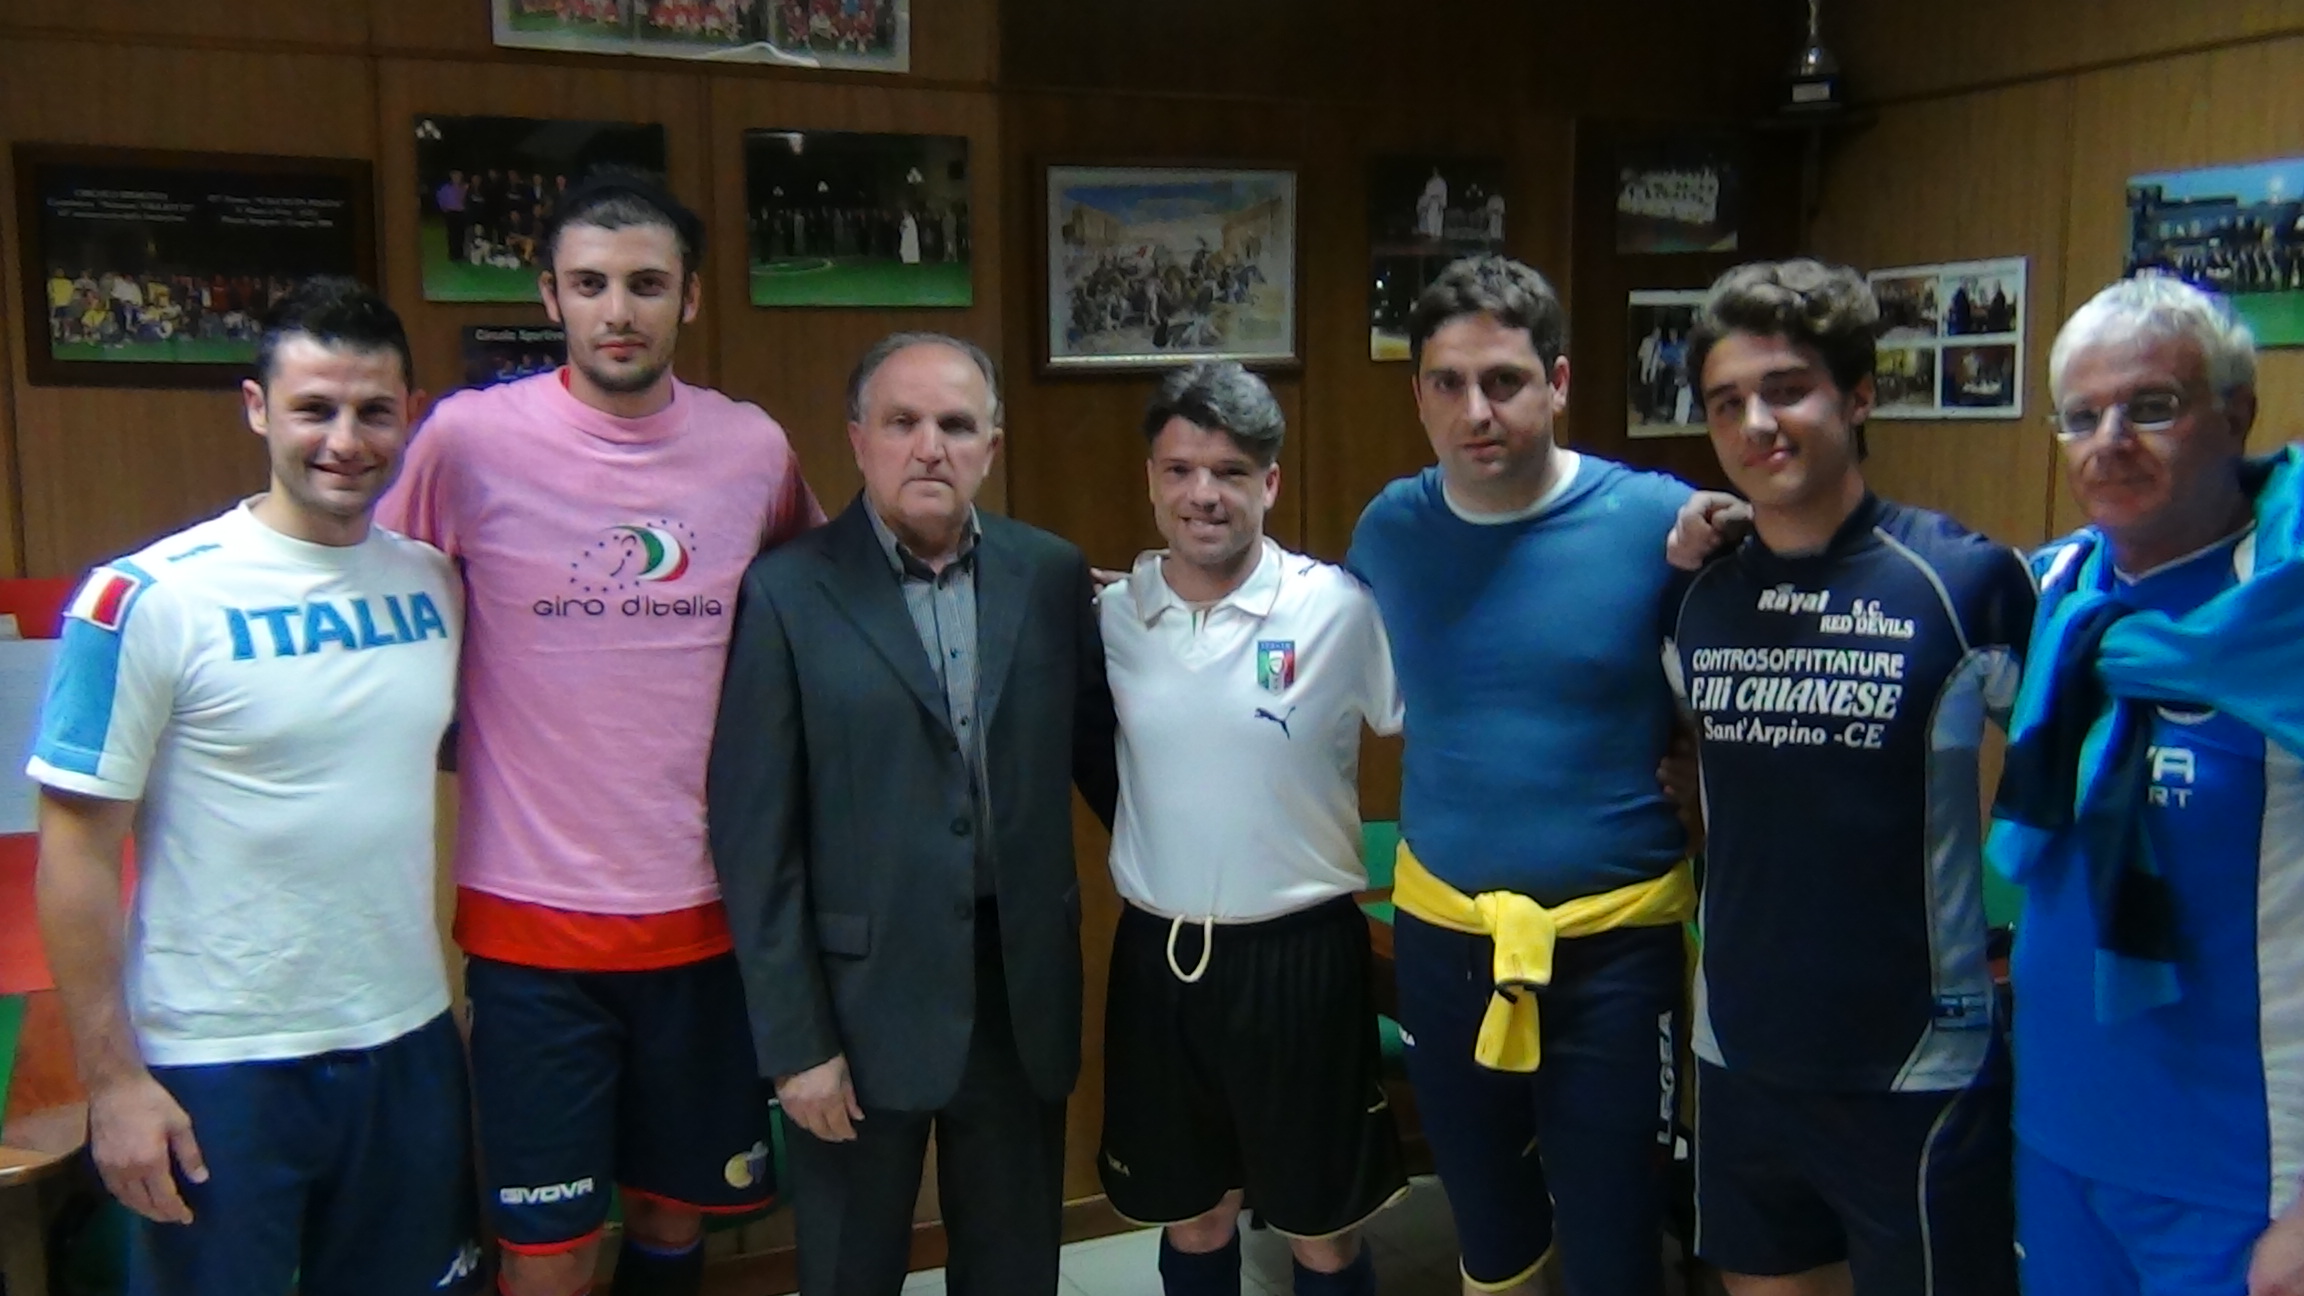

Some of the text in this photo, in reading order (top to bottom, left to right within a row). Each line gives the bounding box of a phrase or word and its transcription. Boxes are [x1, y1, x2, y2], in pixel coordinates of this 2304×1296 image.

[1757, 588, 1831, 616] Royal
[220, 590, 448, 661] ITALIA
[1819, 613, 1916, 640] RED DEVILS
[1691, 648, 1905, 679] CONTROSOFFITTATURE
[1734, 676, 1903, 720] CHIANESE
[1703, 714, 1827, 749] Sant'Arpino
[1656, 1009, 1676, 1146] LEGEA
[499, 1177, 594, 1205] GIVOVA
